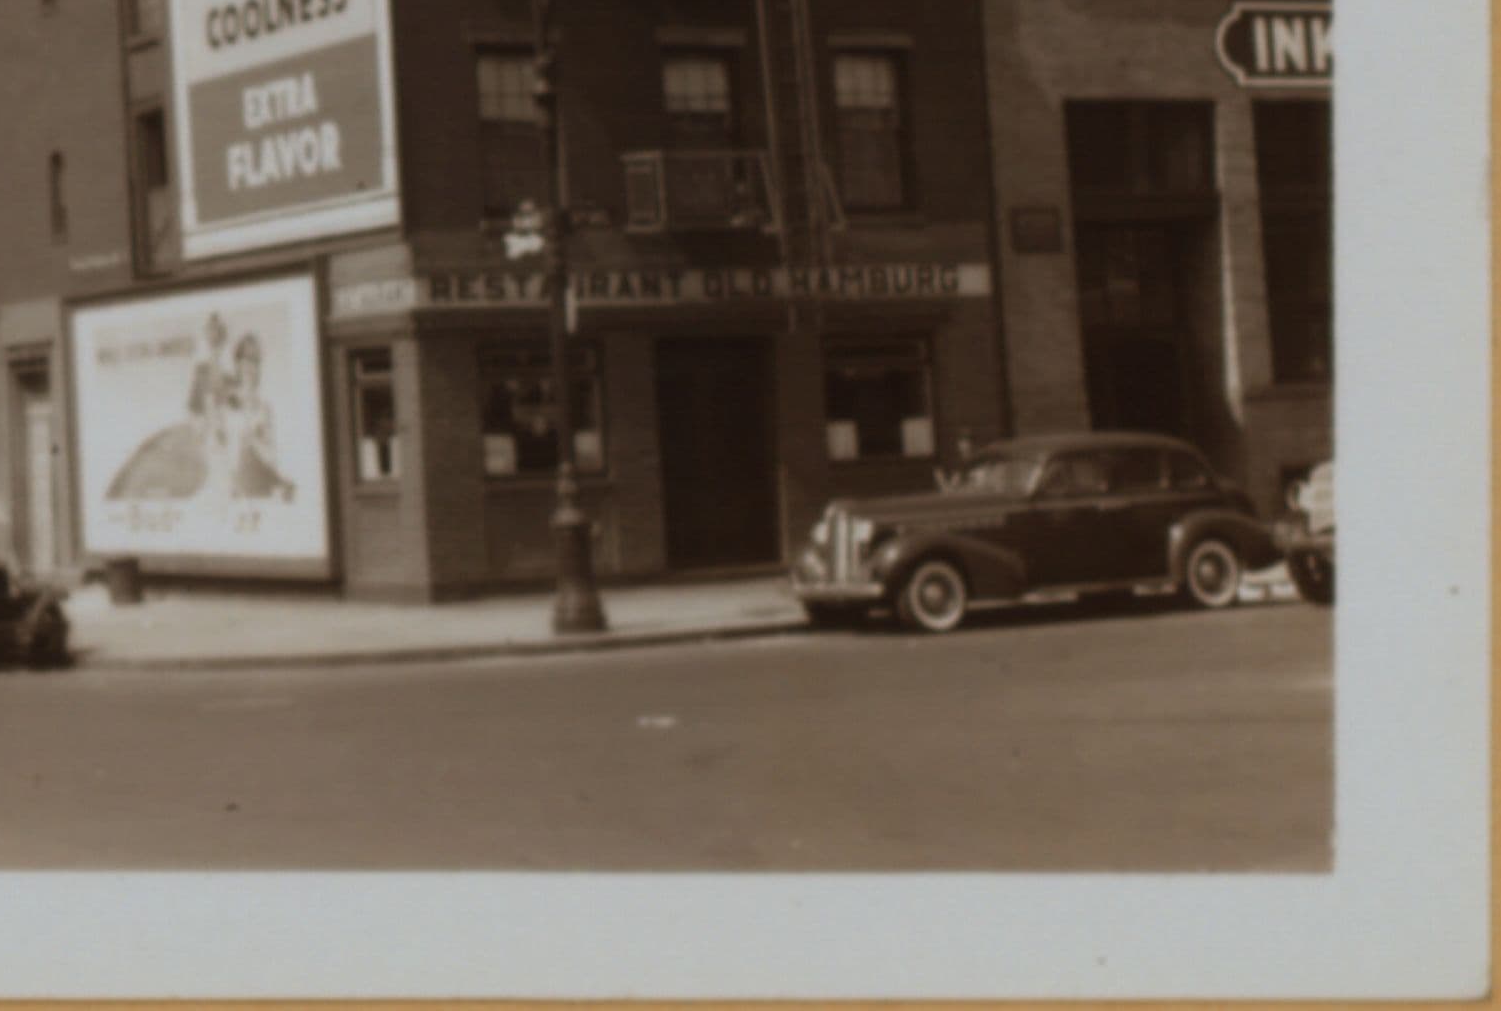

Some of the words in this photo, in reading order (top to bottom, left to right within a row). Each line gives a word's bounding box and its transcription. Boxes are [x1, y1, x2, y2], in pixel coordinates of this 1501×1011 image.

[243, 70, 319, 130] EXTRA
[227, 120, 343, 190] FLAVOR
[702, 267, 769, 297] OLD
[788, 261, 958, 295] HAMBURG
